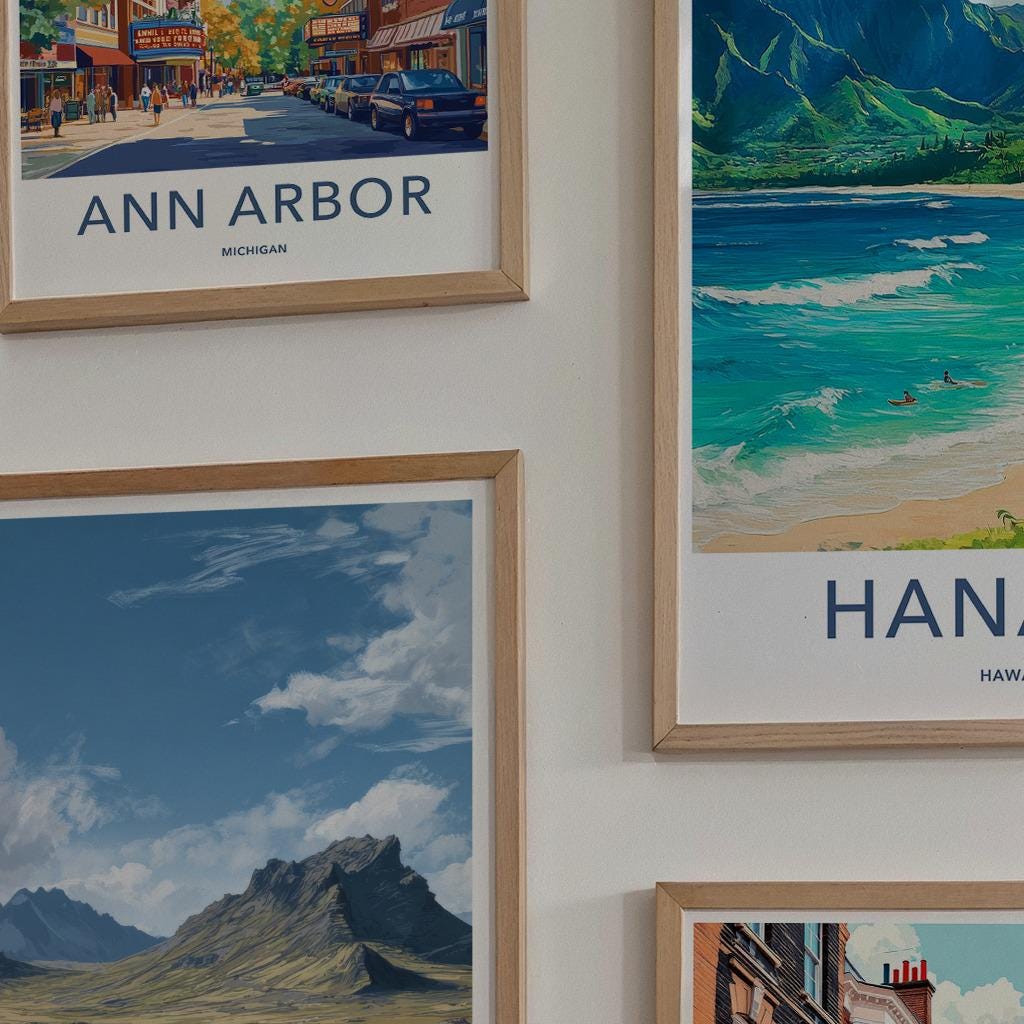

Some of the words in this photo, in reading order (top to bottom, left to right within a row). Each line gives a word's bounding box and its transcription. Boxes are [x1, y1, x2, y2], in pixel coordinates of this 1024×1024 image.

[76, 189, 205, 236] ANN
[228, 176, 431, 227] ARBOR
[221, 243, 287, 257] MICHIGAN
[827, 578, 1024, 639] HAN
[980, 668, 1024, 682] HAW
